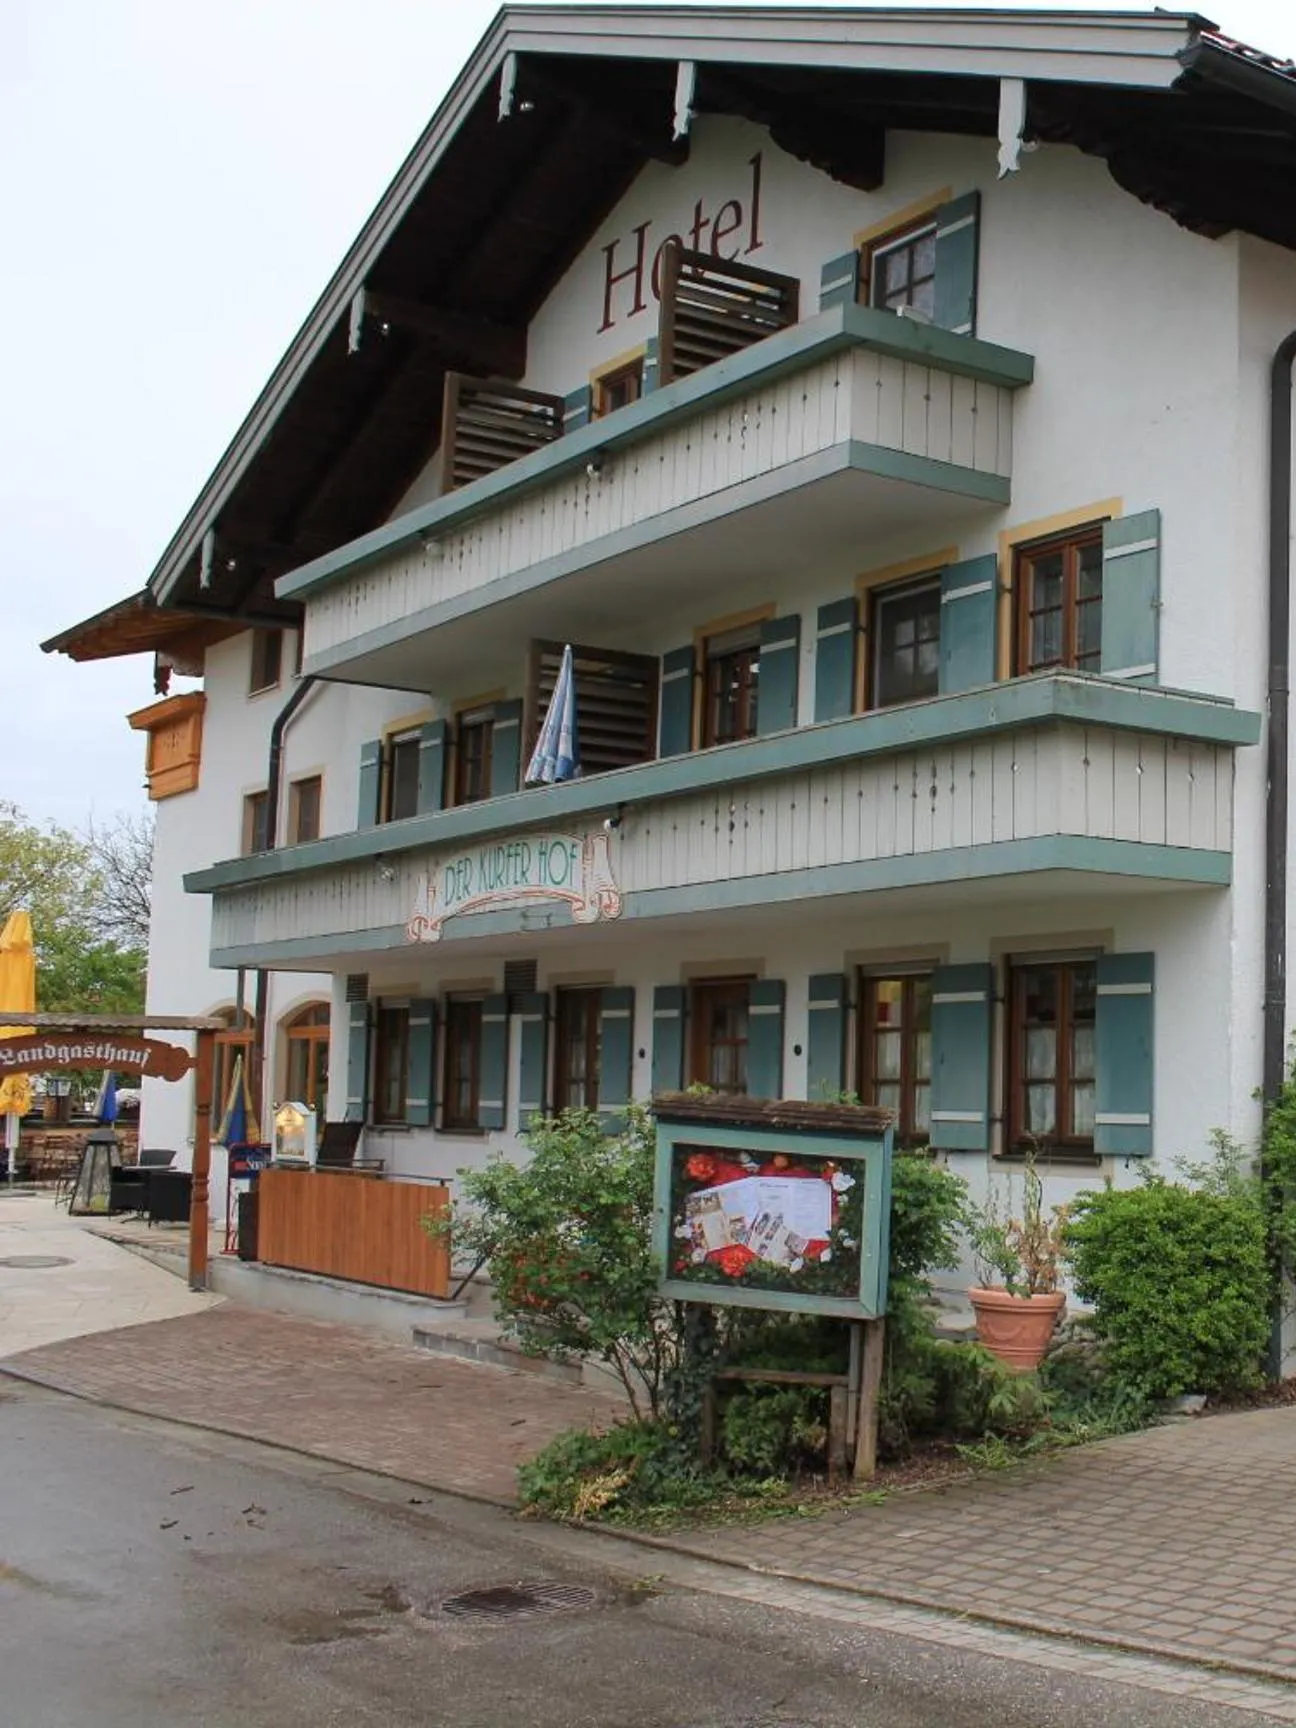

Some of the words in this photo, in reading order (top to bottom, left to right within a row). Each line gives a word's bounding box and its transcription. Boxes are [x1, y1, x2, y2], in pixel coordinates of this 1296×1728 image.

[445, 857, 472, 906] DER
[479, 842, 532, 891] KURFER
[538, 840, 579, 886] HOF
